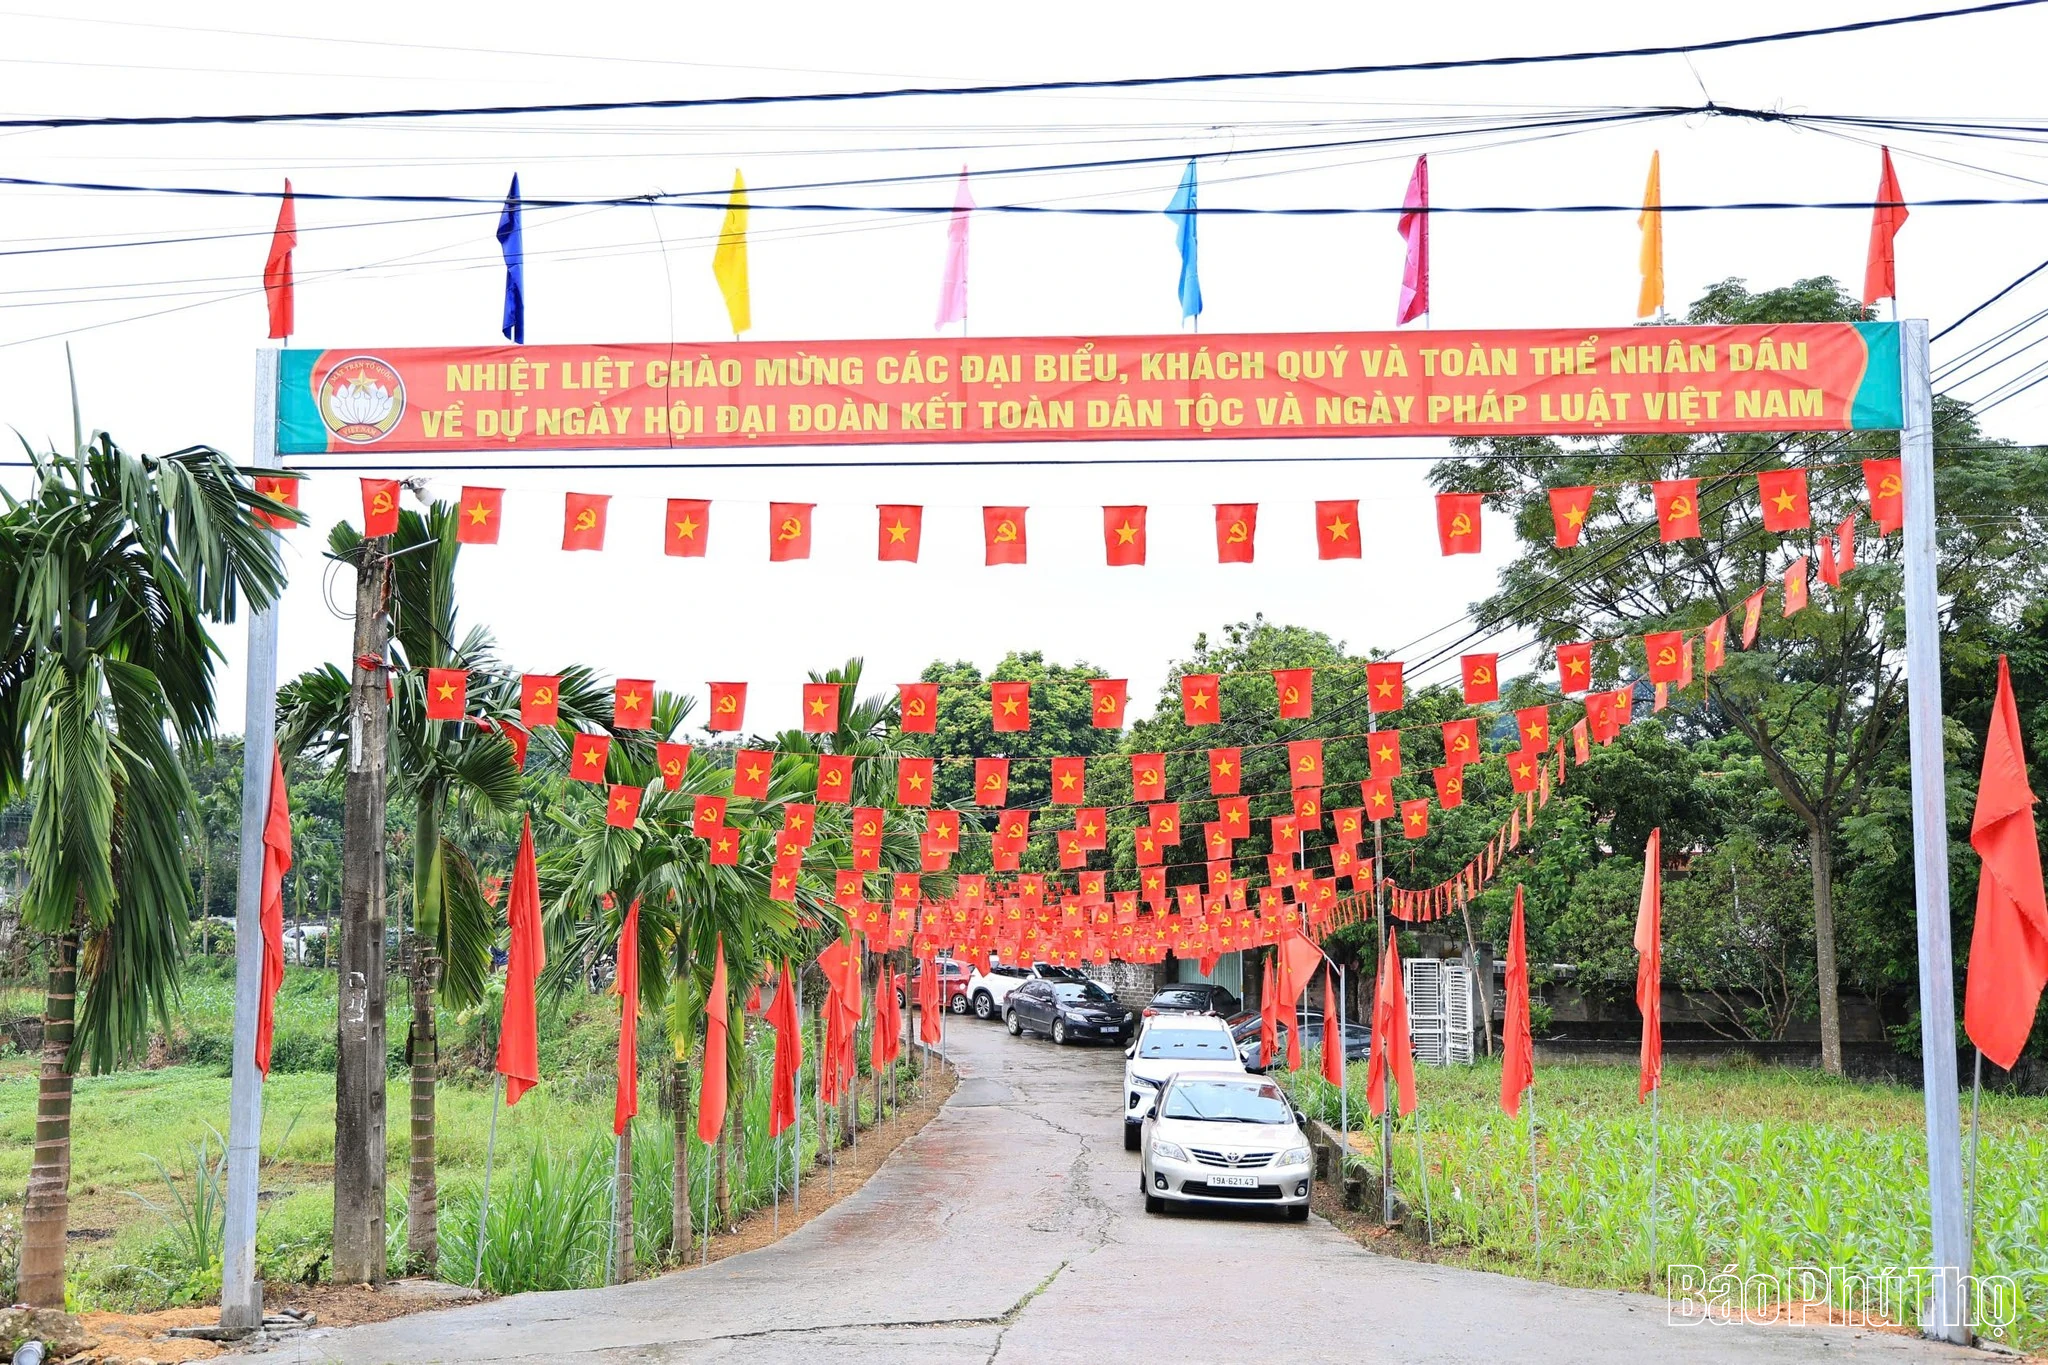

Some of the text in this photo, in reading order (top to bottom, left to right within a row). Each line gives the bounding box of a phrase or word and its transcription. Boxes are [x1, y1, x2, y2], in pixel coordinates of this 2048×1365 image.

[446, 335, 1808, 396] NHIỆT LIỆT CHÀO MỪNG CÁC ĐẠI BIỂU, KHÁCH QUÝ VÀ TOÀN THỂ NHÂN DÂN
[421, 385, 1824, 442] VỀ DỰ NGÀY HỘI ĐẠI ĐOÀN KẾT TOÀN DÂN TỘC VÀ NGÀY PHÁP LUẬT VIỆT NAM
